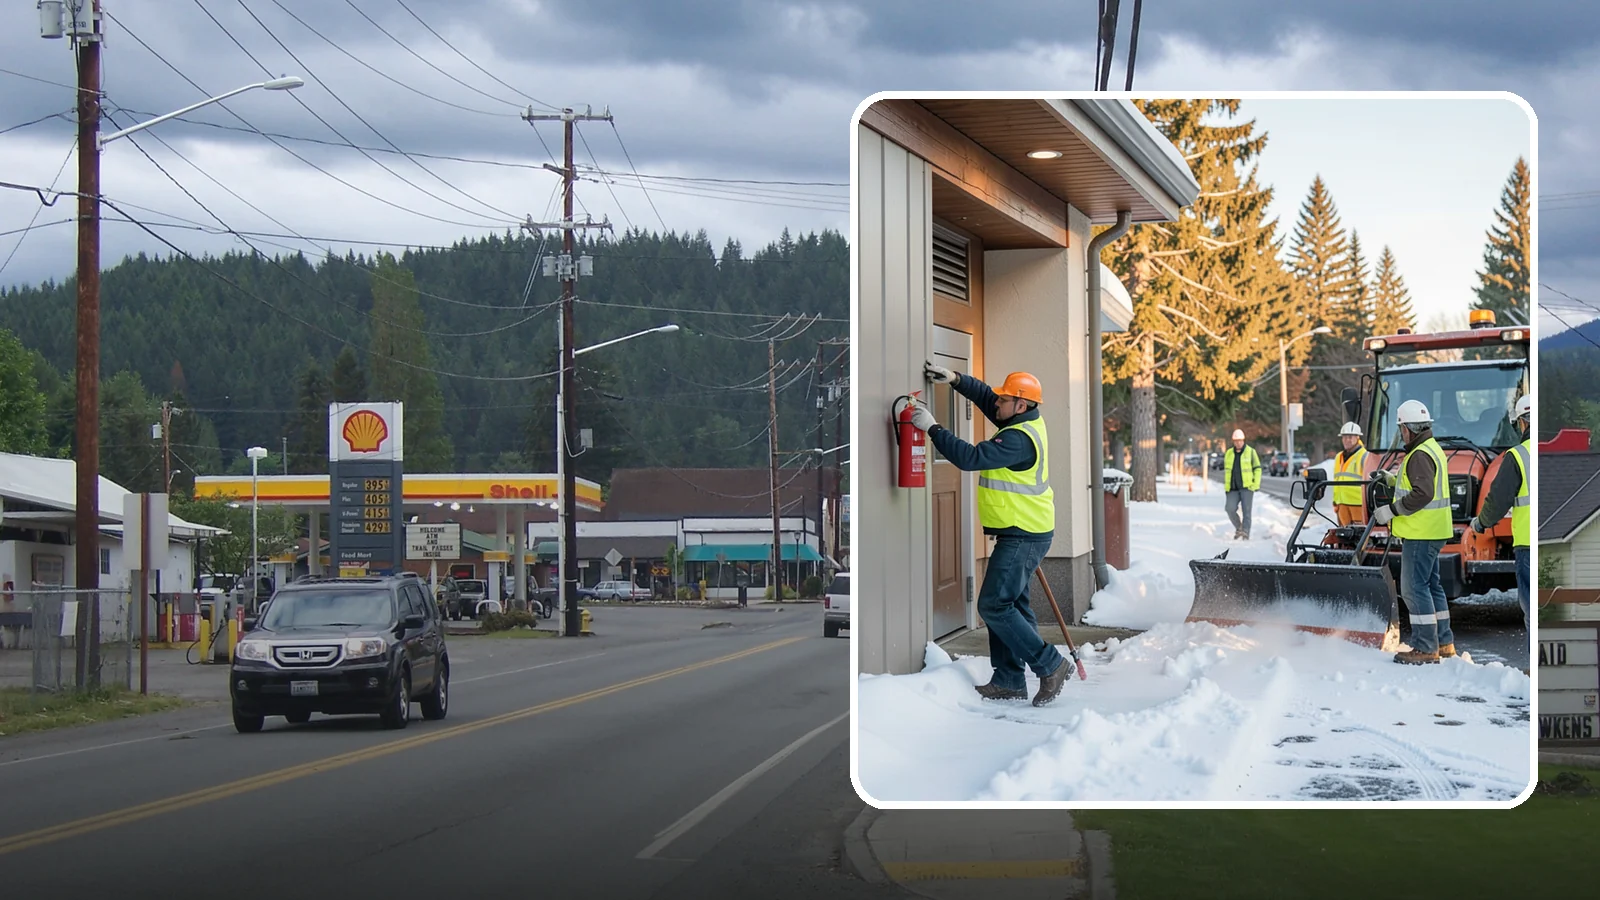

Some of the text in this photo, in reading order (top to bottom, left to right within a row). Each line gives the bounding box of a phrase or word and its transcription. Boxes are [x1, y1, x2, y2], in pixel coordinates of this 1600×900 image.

[366, 480, 383, 490] 395
[490, 484, 547, 498] Shell
[366, 494, 383, 504] 405
[366, 508, 383, 518] 415
[366, 522, 383, 532] 429
